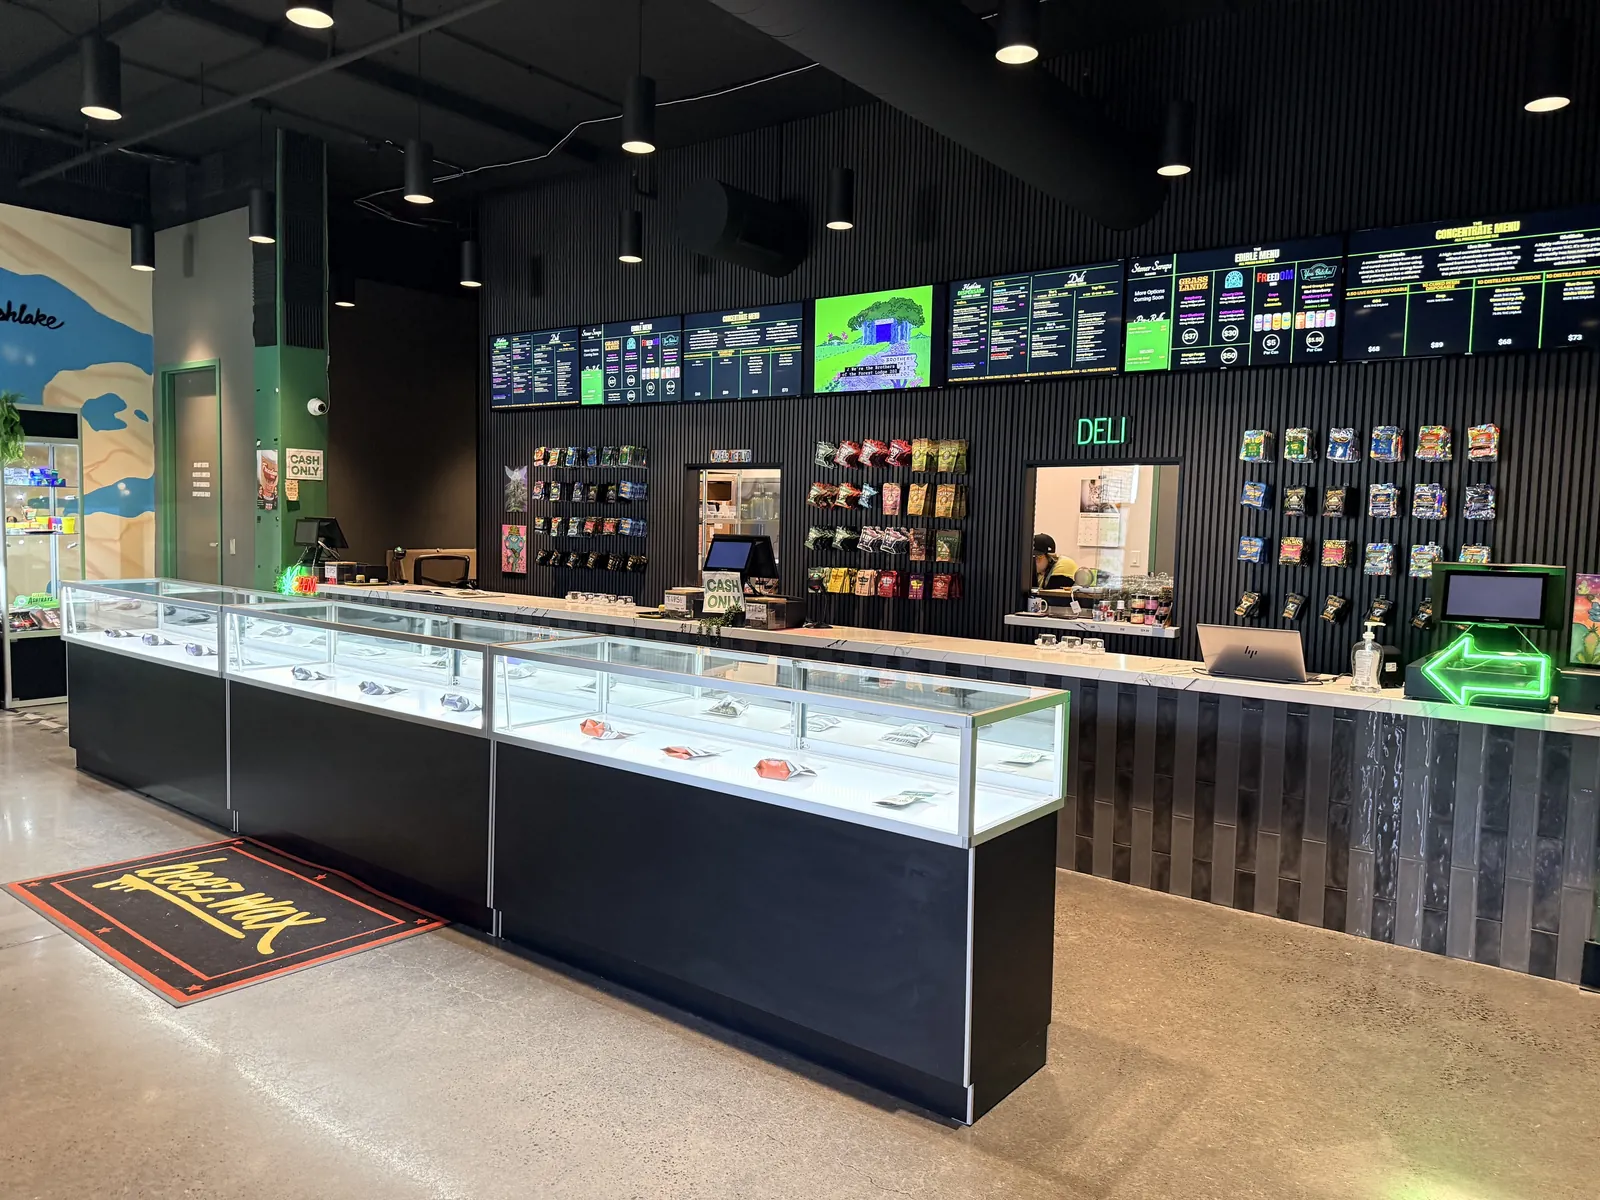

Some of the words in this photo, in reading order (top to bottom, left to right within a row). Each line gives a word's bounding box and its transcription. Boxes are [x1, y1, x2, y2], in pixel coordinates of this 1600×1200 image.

[1436, 224, 1493, 240] CONCENTRATE
[1494, 221, 1520, 233] MENU
[1235, 252, 1258, 262] EDIBLE
[1259, 249, 1280, 259] MENU
[1067, 270, 1087, 283] Deli
[1179, 276, 1208, 284] GRASS
[1257, 269, 1293, 282] FREEDOM
[1179, 283, 1208, 292] LANDZ
[1077, 416, 1126, 445] DELI
[290, 455, 320, 465] CASH
[291, 466, 320, 476] ONLY
[707, 579, 740, 593] CASH
[707, 595, 741, 608] ONLY
